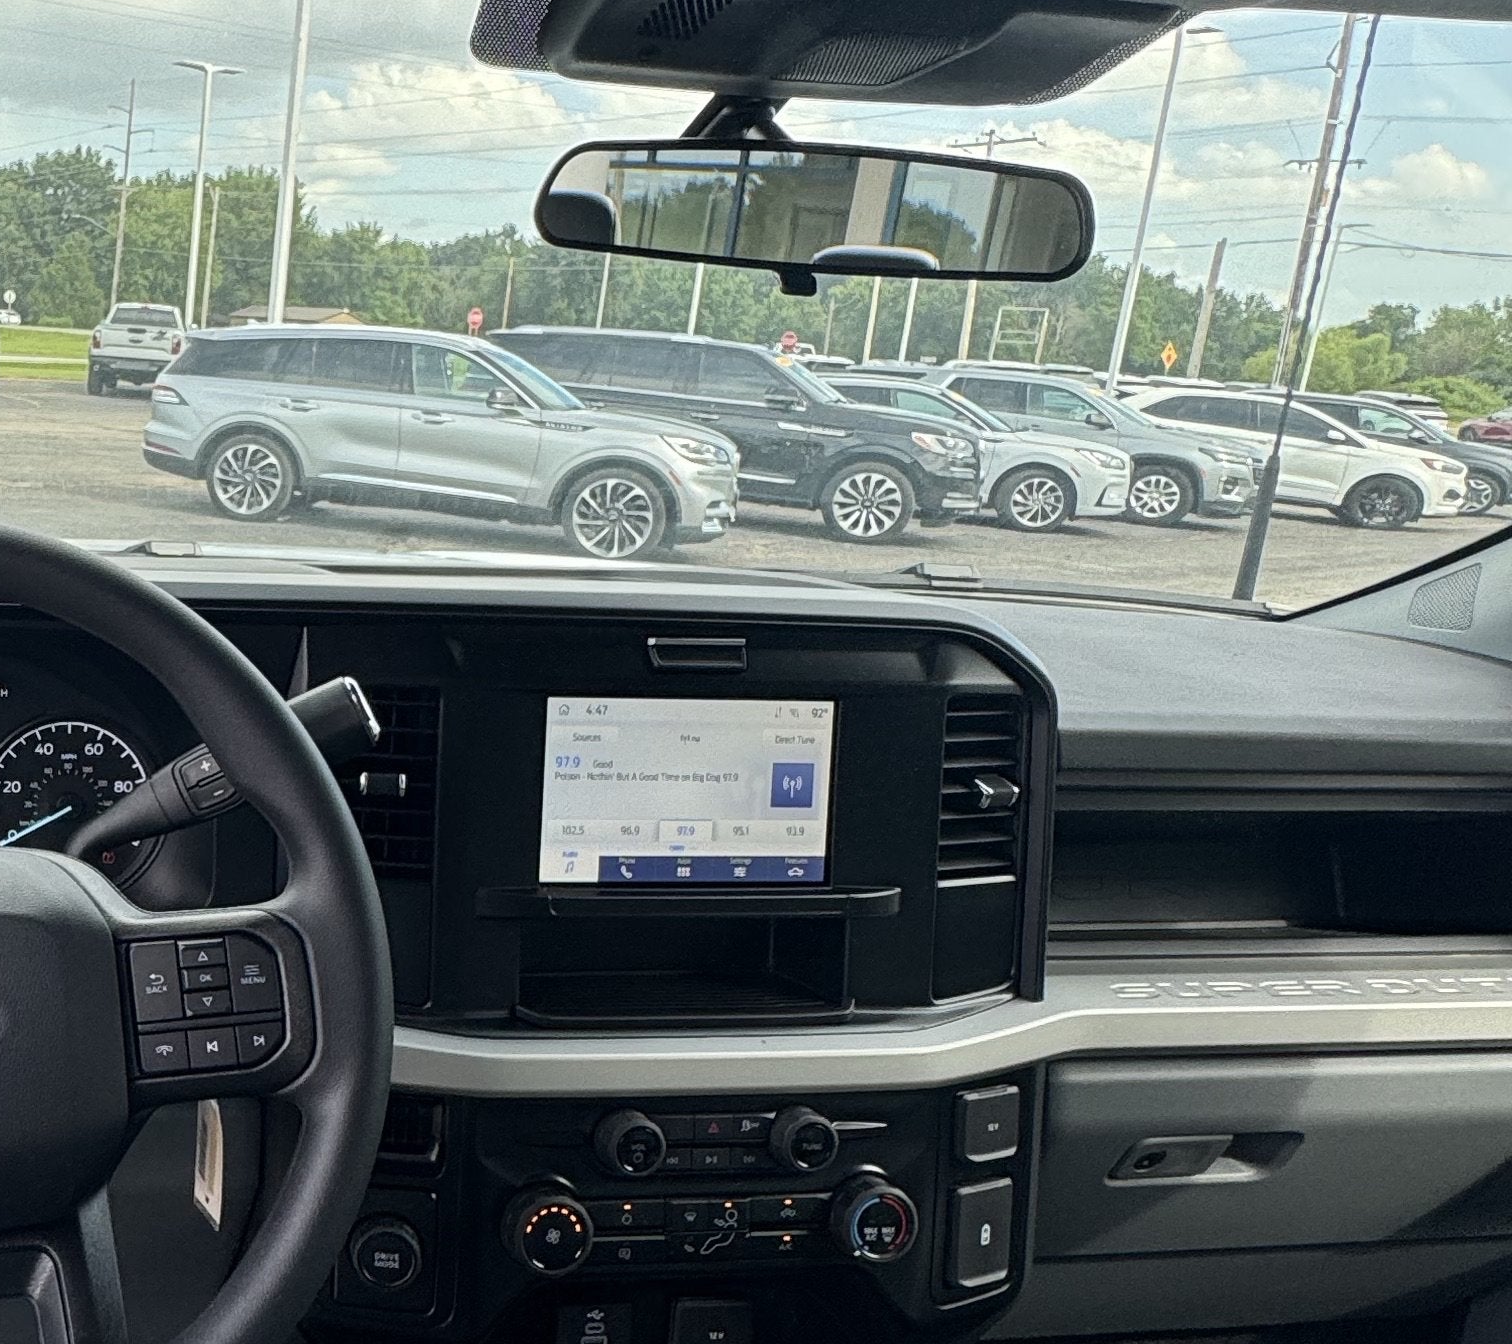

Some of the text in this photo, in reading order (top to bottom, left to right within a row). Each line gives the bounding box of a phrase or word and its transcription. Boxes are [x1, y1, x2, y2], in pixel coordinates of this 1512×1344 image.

[0, 689, 8, 697] H
[572, 733, 601, 742] Sources
[35, 743, 53, 755] 40
[84, 743, 103, 755] 60
[556, 756, 580, 768] 97.9
[631, 772, 636, 780] A
[3, 781, 21, 793] 20
[114, 781, 133, 793] 80
[677, 826, 695, 836] 97.9
[200, 974, 212, 982] OK
[240, 976, 266, 985] MENU
[146, 985, 168, 994] BACK
[1110, 976, 1512, 999] SUPER DUT
